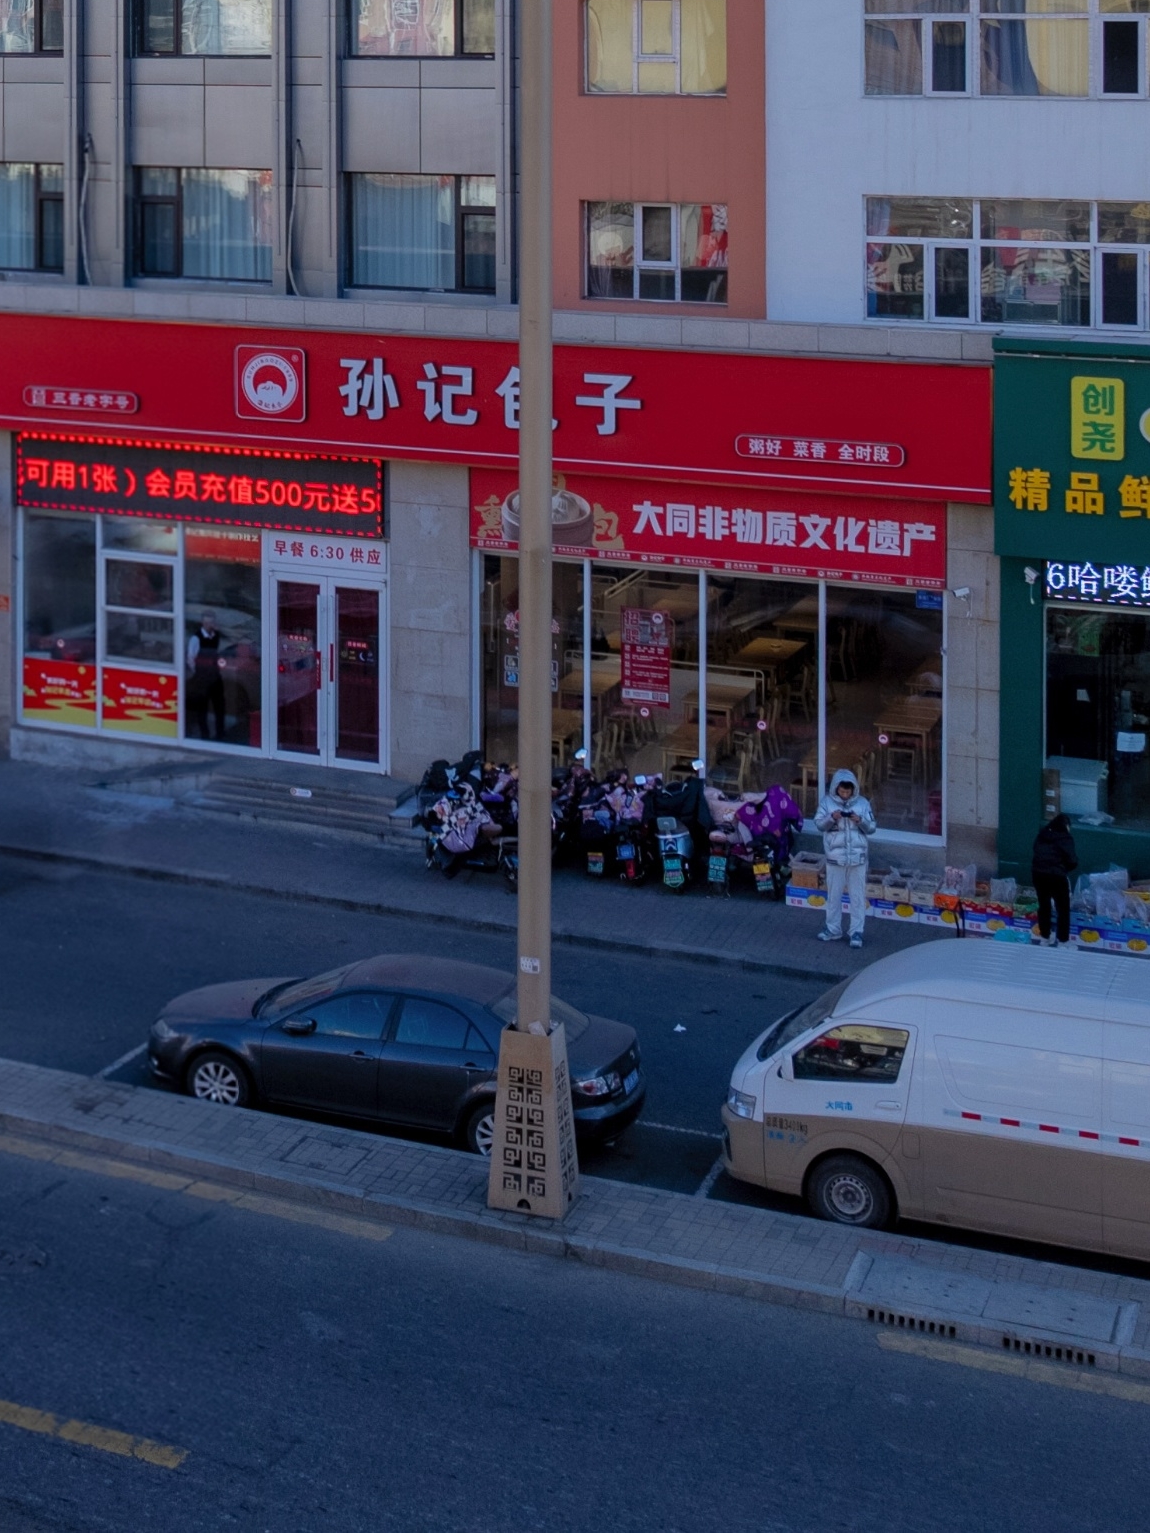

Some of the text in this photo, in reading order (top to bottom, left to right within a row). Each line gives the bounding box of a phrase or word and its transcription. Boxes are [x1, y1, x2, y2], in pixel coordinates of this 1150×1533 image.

[1081, 383, 1115, 454] 创尧
[793, 440, 827, 458] 菜香
[838, 443, 890, 464] 全时段
[26, 458, 380, 514] 可用1张）会员充值500元送5
[274, 540, 381, 565] 早餐 6:30 供应
[632, 500, 936, 557] 大同非物质文化遗产
